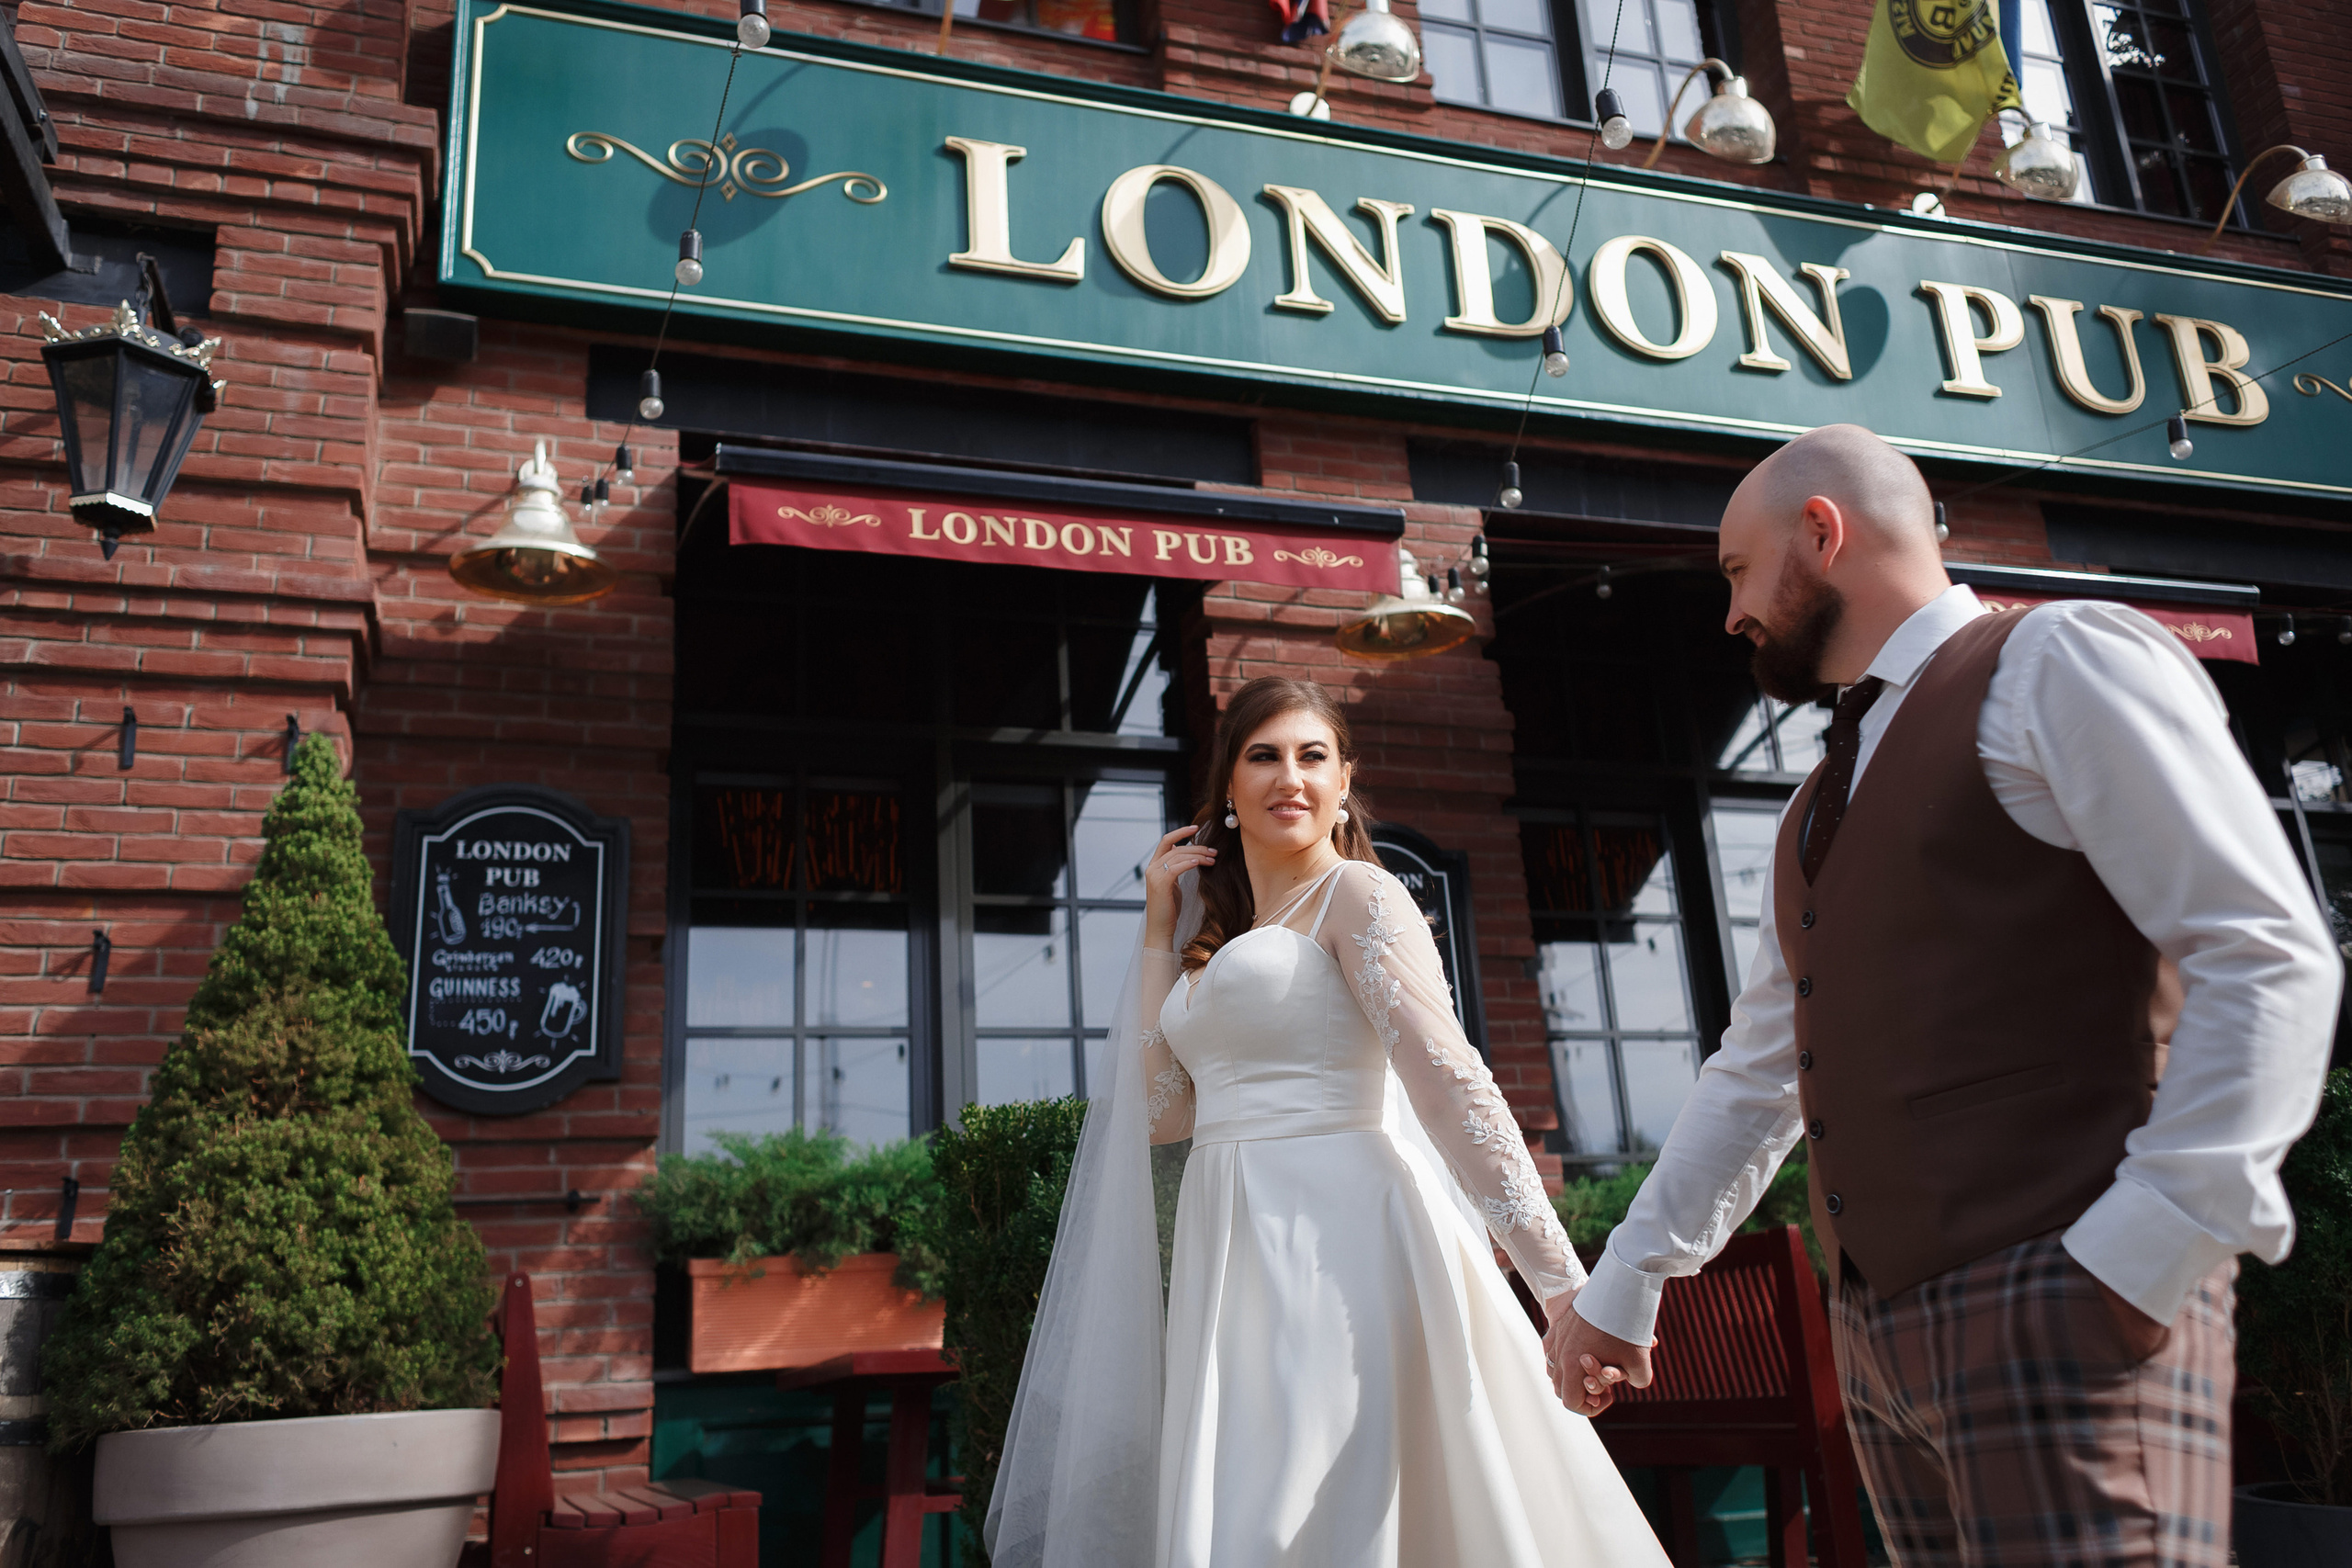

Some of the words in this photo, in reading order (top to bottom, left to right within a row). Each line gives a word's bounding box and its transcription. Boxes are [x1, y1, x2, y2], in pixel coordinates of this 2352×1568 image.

[944, 135, 1852, 380] LONDON
[1919, 279, 2270, 426] PUB
[907, 507, 1133, 557] LONDON
[1152, 528, 1255, 567] PUB
[456, 840, 571, 863] LONDON
[486, 866, 541, 887] PUB
[429, 976, 522, 1000] GUINNESS
